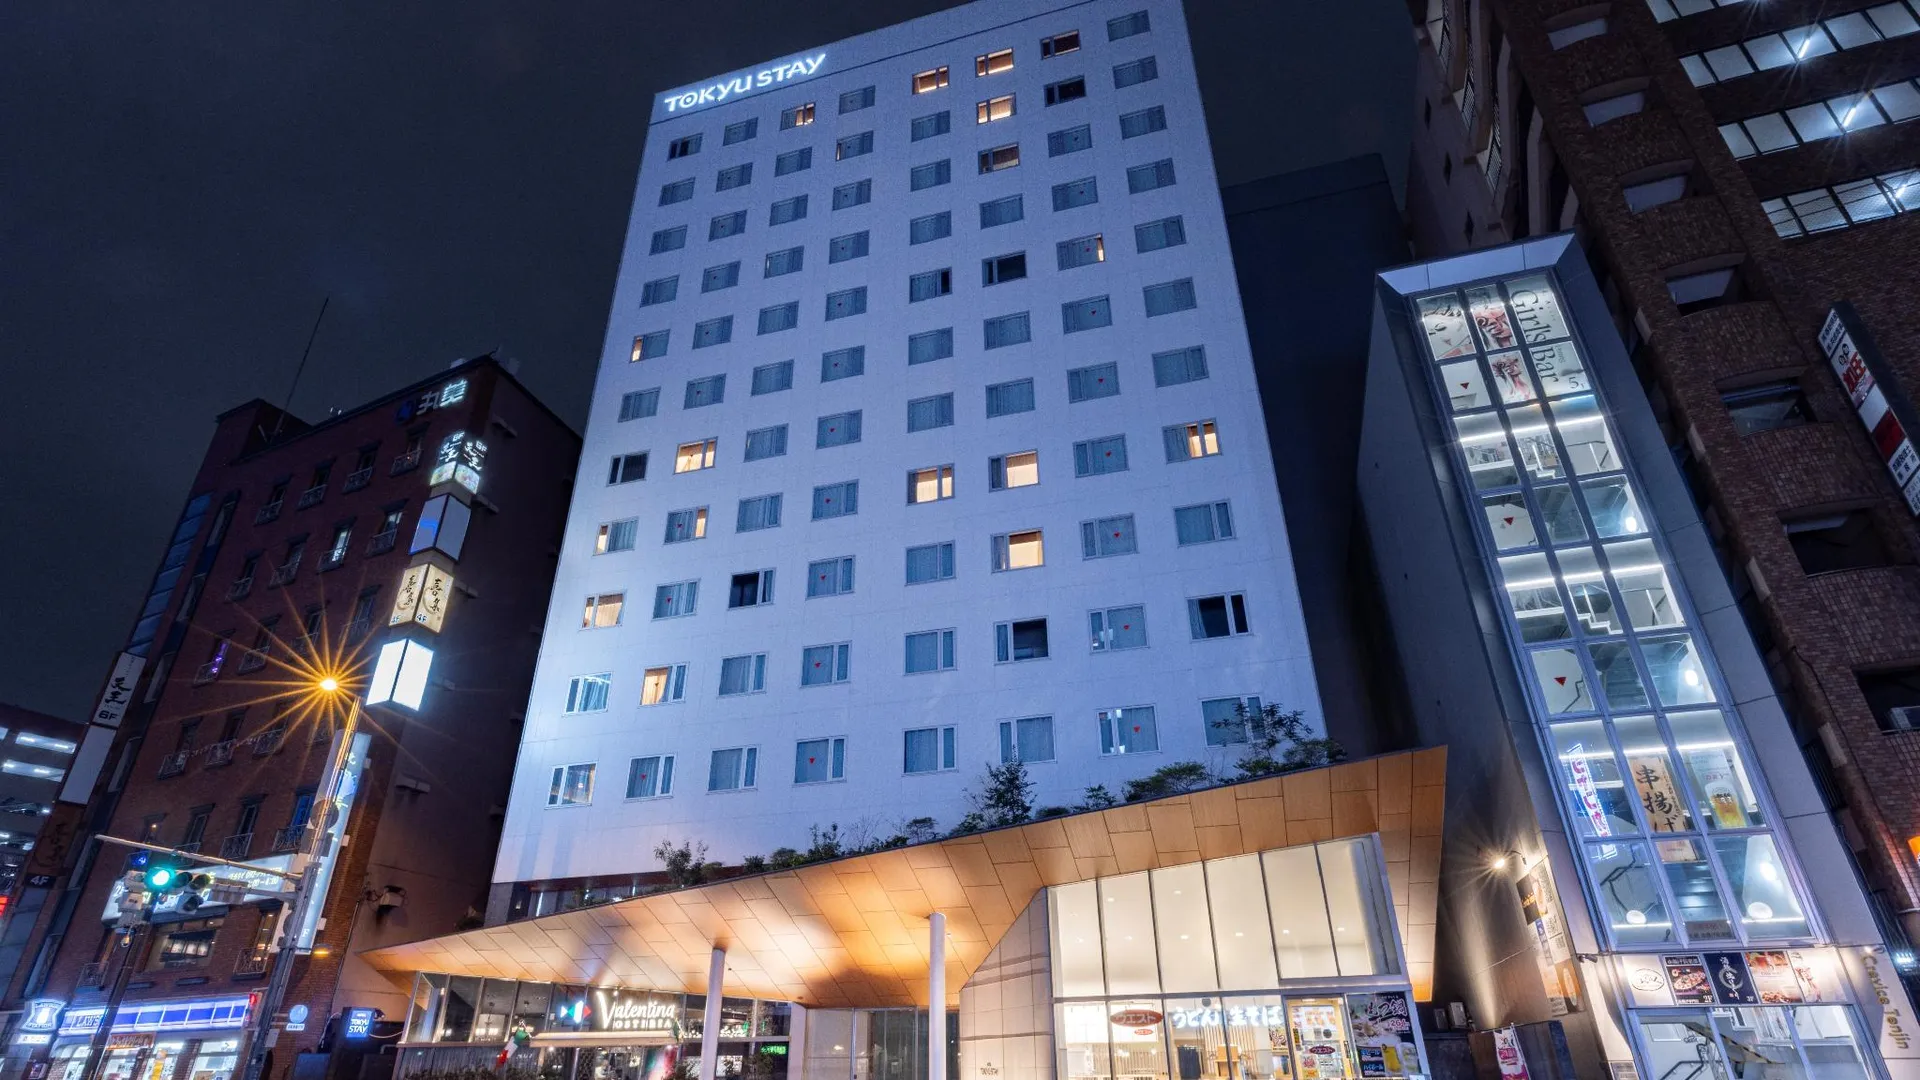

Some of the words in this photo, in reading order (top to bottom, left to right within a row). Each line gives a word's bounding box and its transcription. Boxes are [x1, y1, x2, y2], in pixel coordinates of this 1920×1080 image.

[665, 75, 753, 112] TOKYU
[756, 53, 827, 88] STAY
[1531, 346, 1559, 383] Bar
[98, 709, 118, 721] 6F
[30, 875, 50, 886] 4F
[596, 988, 677, 1030] Valentina
[1861, 955, 1891, 1006] Crevice
[1884, 1008, 1911, 1050] Tenjin
[348, 1025, 368, 1033] STAY
[1114, 1013, 1157, 1025] ウエスト
[1173, 1007, 1219, 1029] うどん
[1228, 1005, 1284, 1027] 生そば
